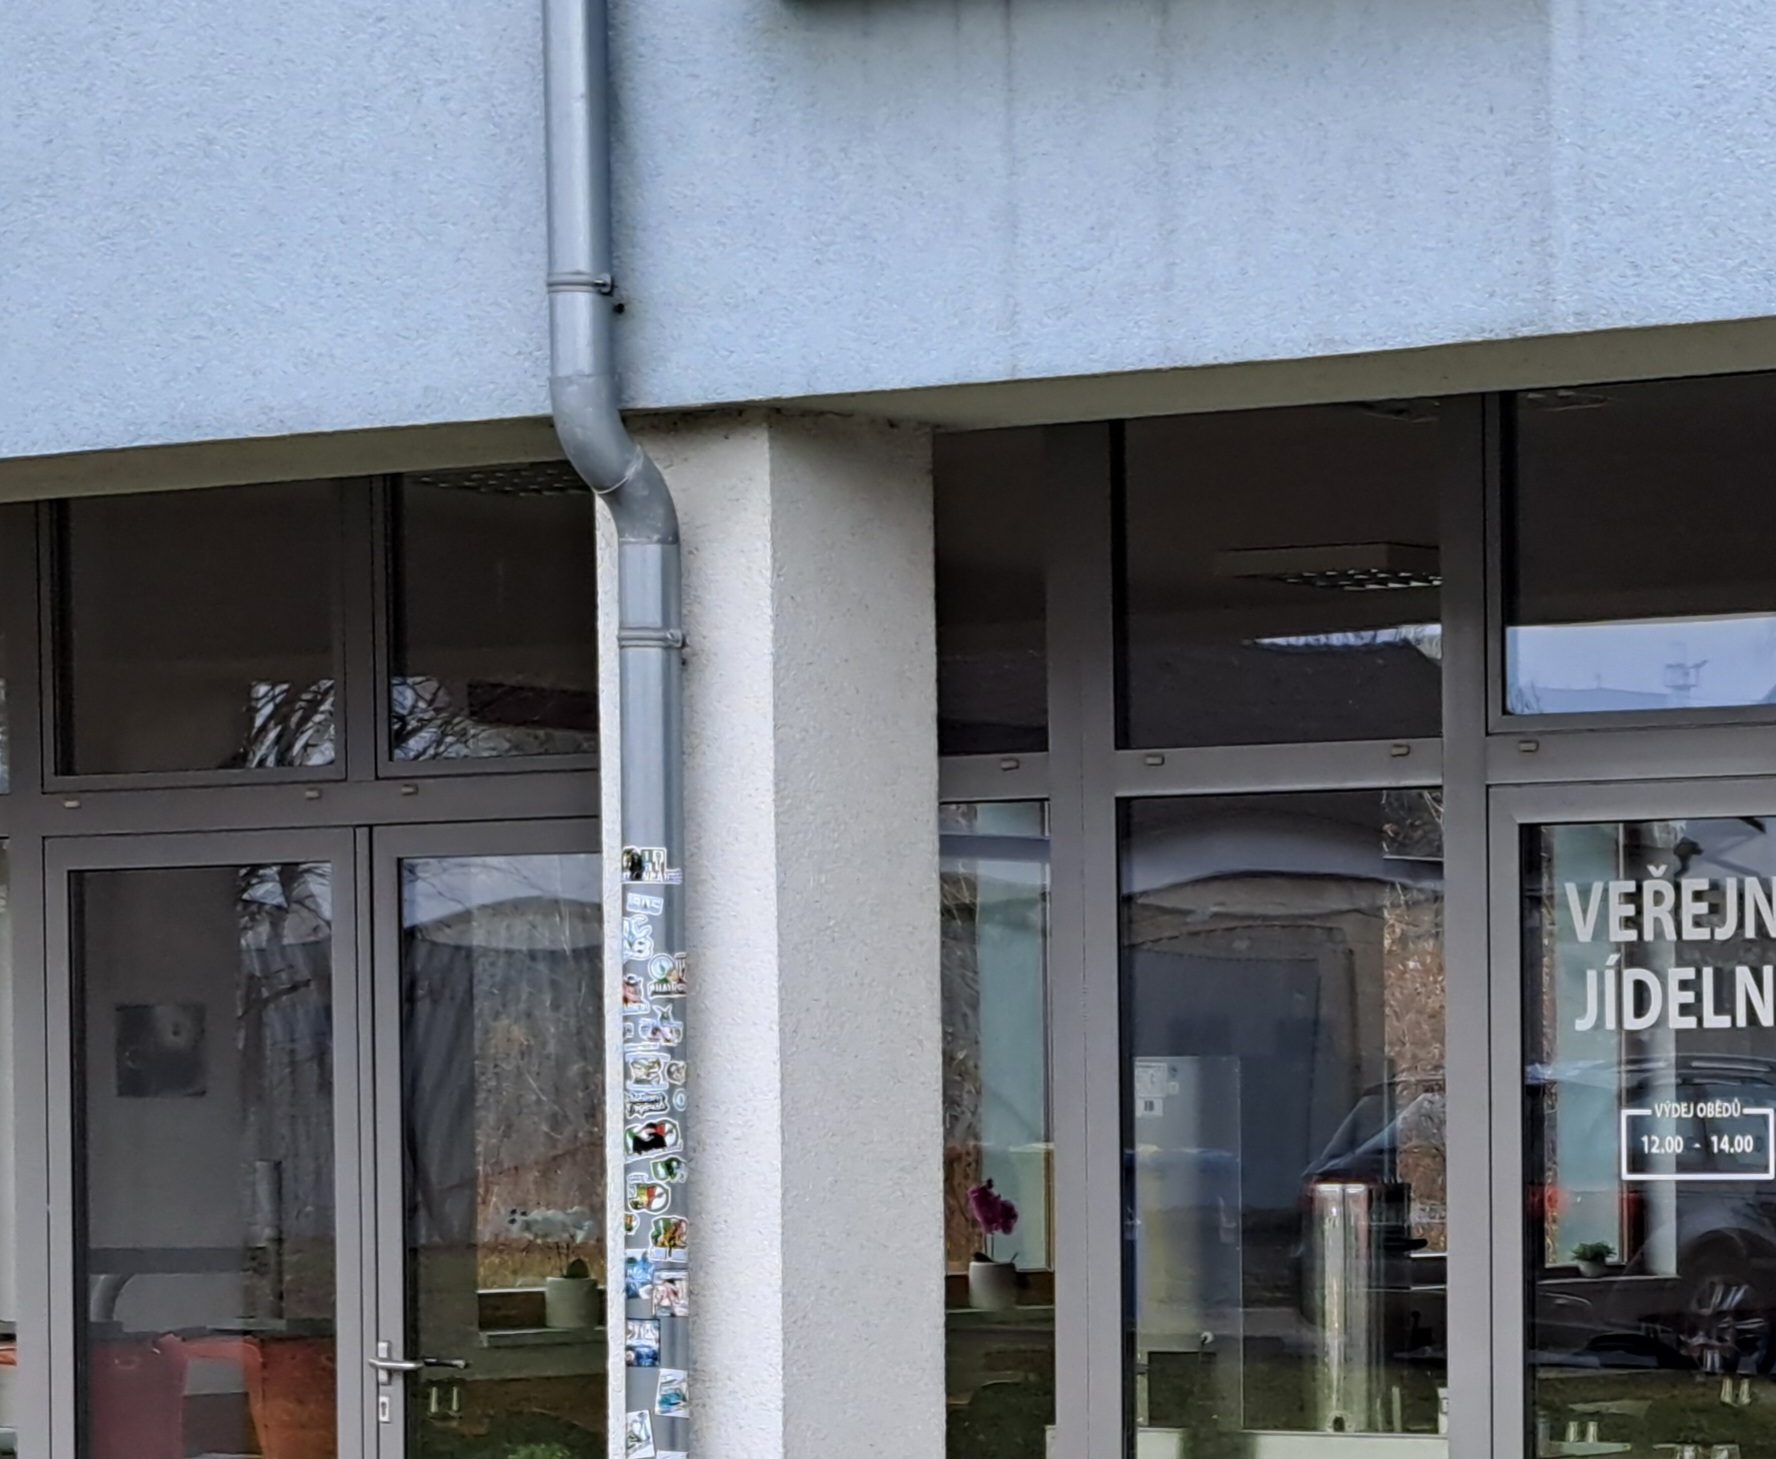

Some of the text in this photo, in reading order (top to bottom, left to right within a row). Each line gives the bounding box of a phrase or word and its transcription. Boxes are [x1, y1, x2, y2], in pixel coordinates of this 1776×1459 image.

[1655, 1098, 1741, 1118] VÝDEJ OBĚDŮ
[1640, 1134, 1684, 1154] 12.00
[1710, 1134, 1754, 1153] 14.00
